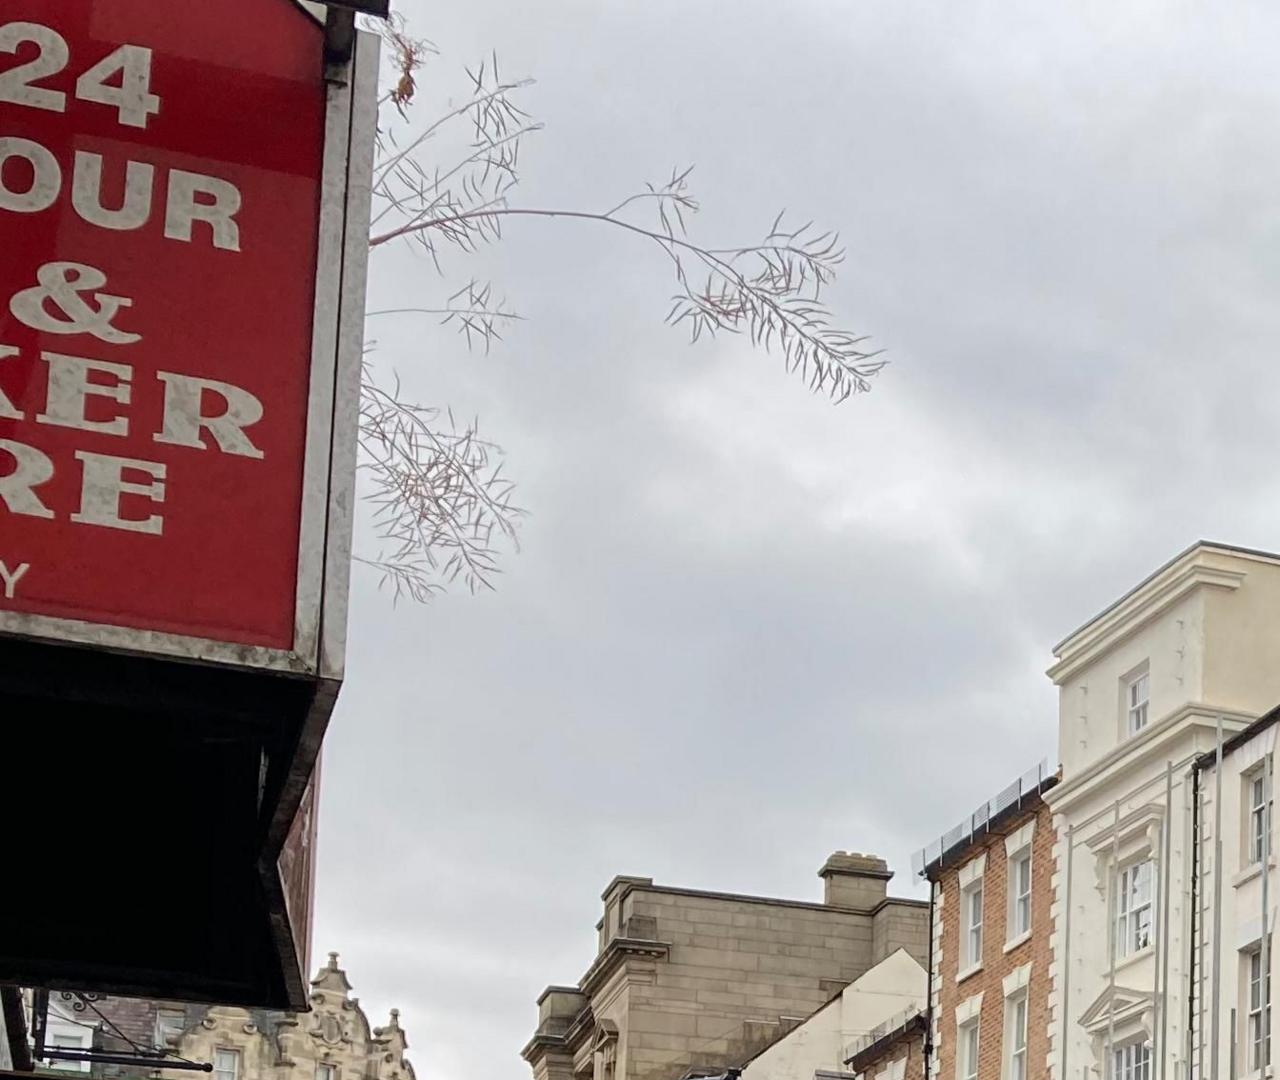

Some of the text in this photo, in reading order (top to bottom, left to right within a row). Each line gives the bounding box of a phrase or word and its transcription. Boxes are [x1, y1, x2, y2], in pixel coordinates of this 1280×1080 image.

[0, 22, 160, 129] 24
[9, 261, 142, 344] &
[0, 345, 264, 459] ER
